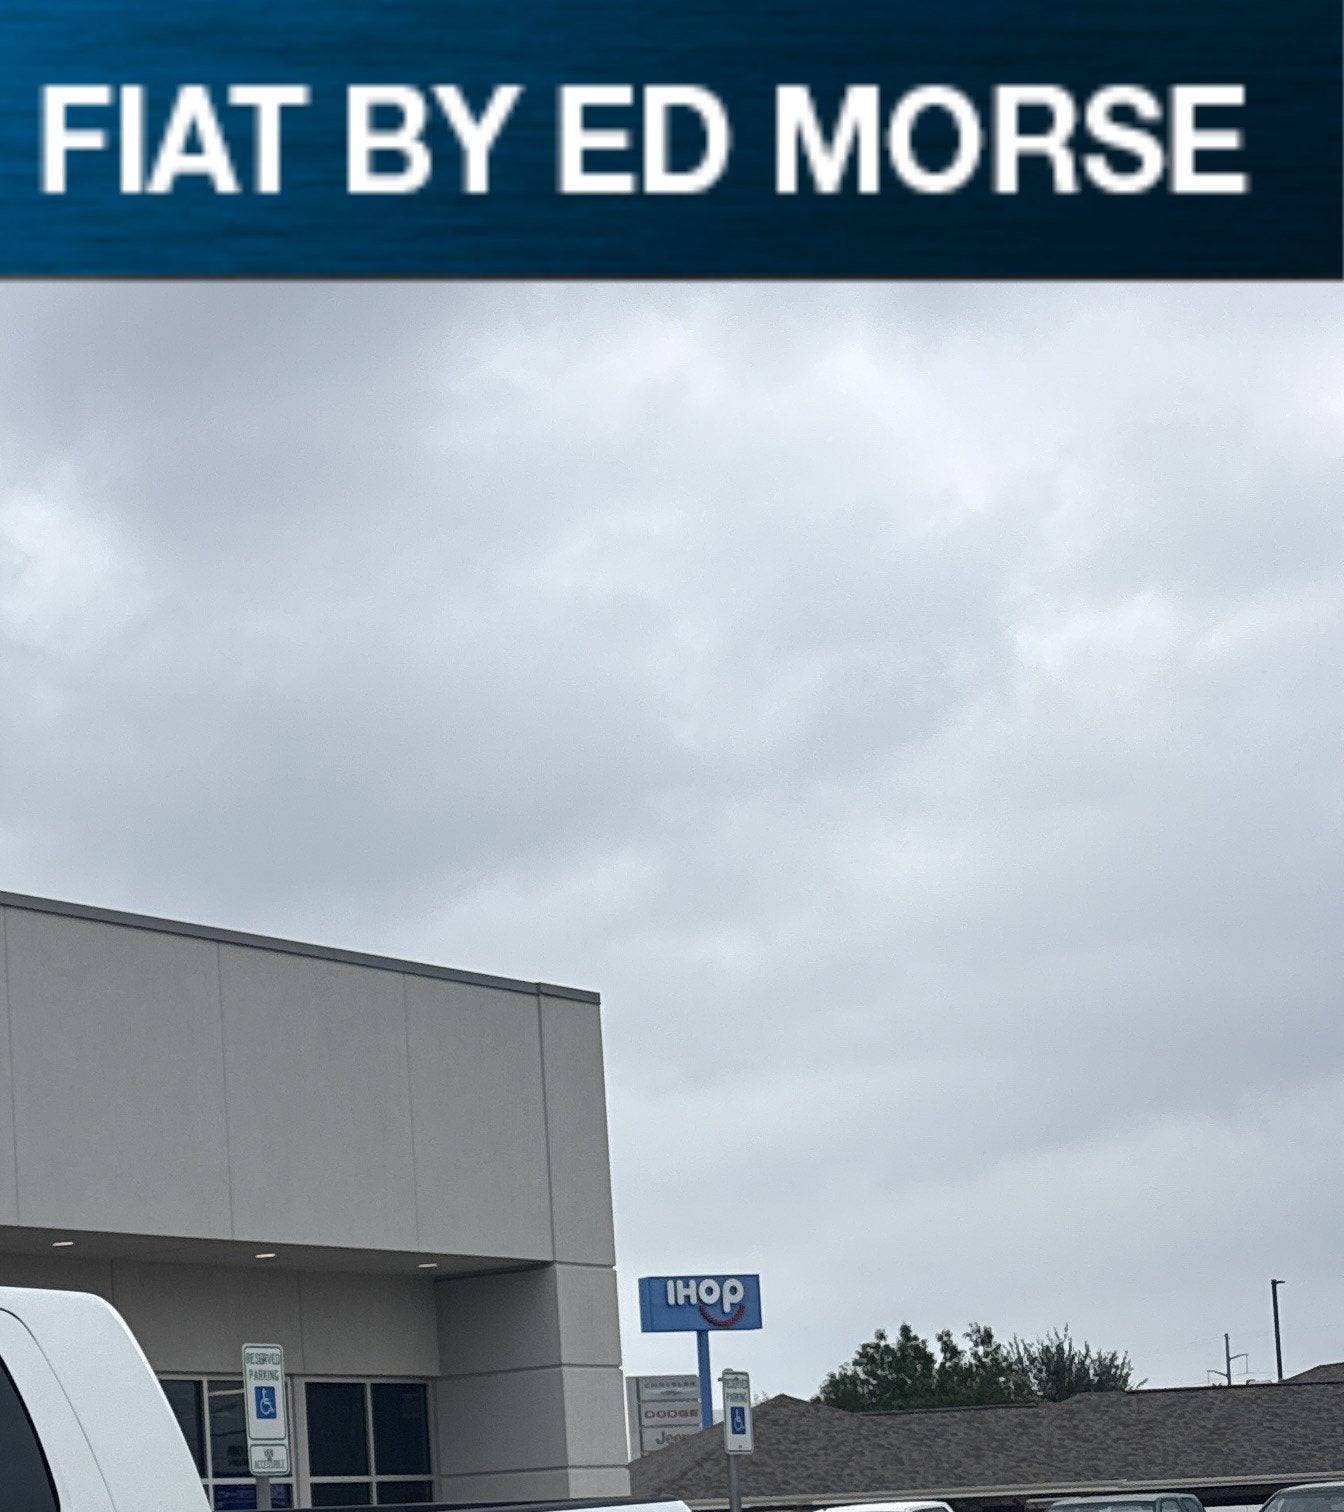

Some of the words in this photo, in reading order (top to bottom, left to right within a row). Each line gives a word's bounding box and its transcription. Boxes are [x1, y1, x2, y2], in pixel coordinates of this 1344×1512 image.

[667, 1279, 745, 1313] IHOP
[248, 1369, 280, 1381] PARKING
[644, 1408, 699, 1419] DODGE
